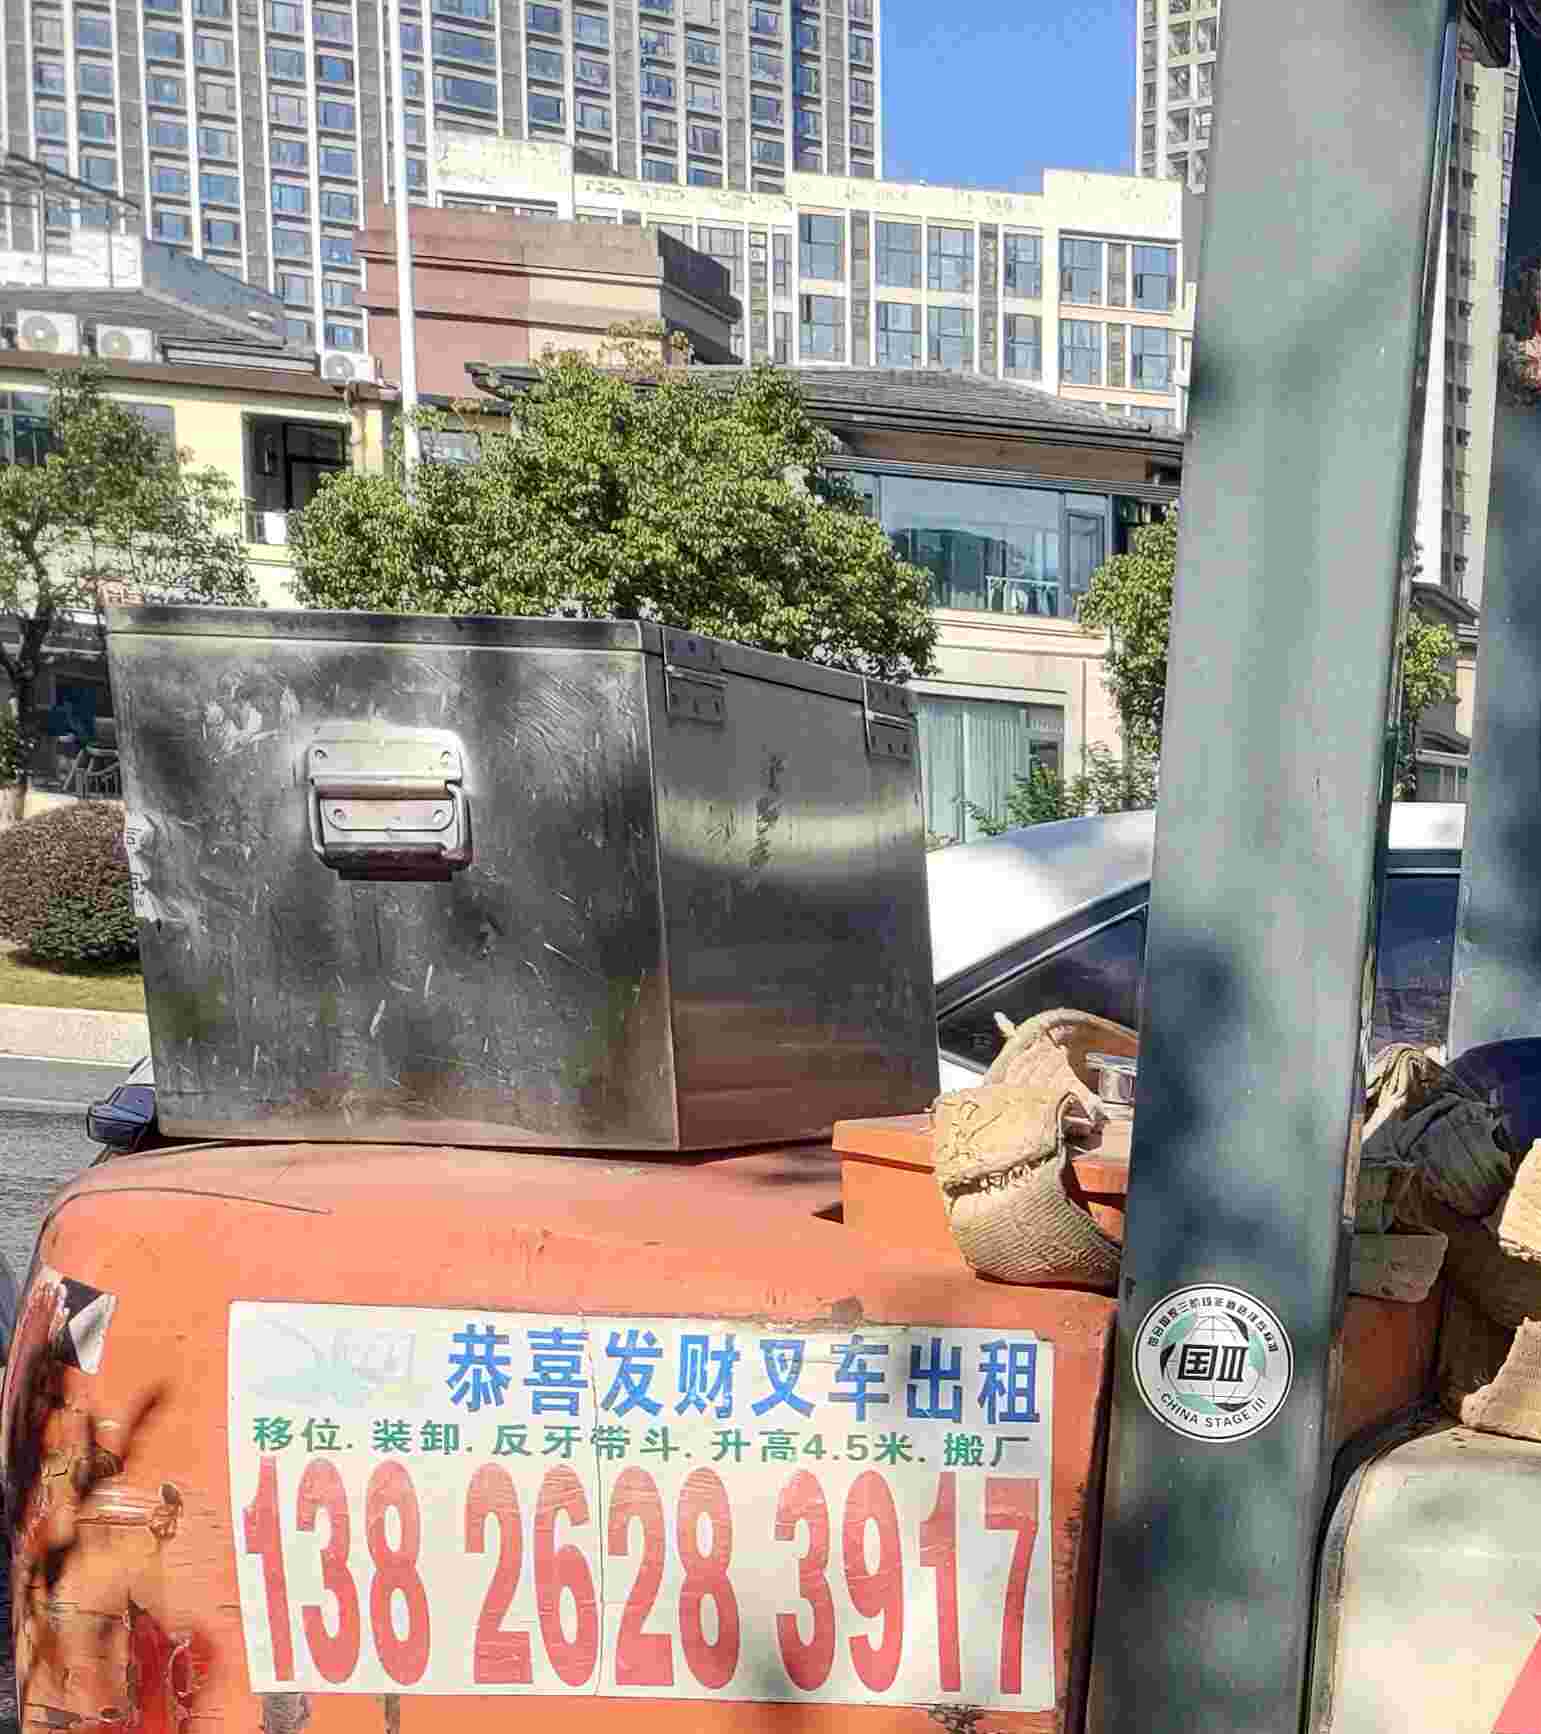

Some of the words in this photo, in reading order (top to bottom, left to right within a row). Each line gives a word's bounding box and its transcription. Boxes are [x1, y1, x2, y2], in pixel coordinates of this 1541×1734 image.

[445, 1322, 1042, 1427] 恭喜发财叉车出租
[1160, 1391, 1199, 1426] CHINA
[1204, 1410, 1251, 1429] STAGE
[241, 1454, 432, 1686] 138
[463, 1461, 742, 1689] 2628
[773, 1468, 1041, 1695] 3917
